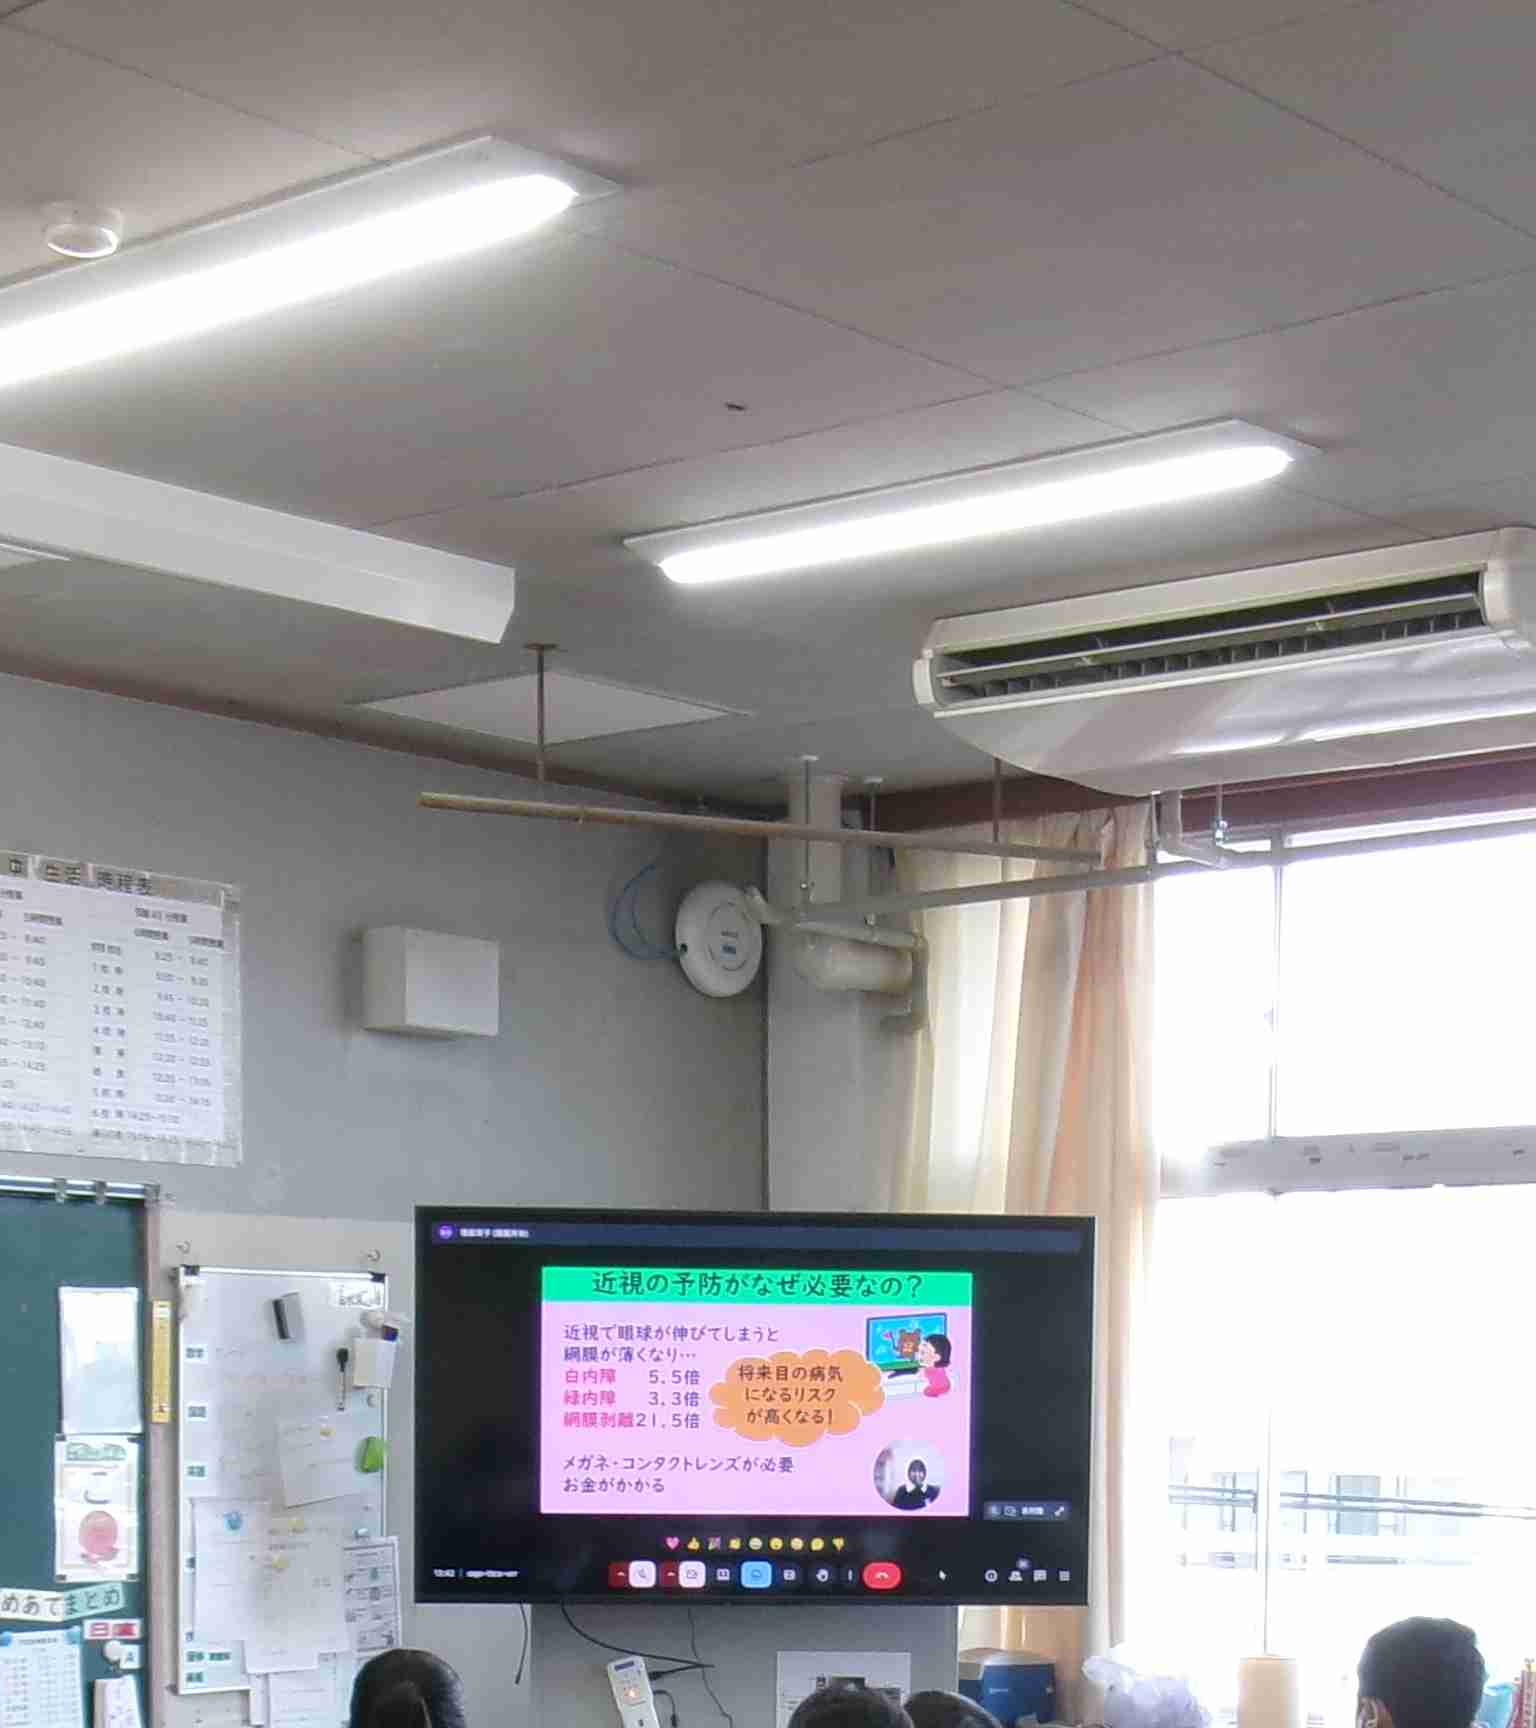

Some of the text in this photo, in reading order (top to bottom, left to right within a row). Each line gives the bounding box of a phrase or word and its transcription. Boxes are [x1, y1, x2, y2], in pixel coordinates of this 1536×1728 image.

[592, 1270, 923, 1300] 近視の予防がなぜ必要なの?
[563, 1323, 780, 1343] 近視で眼球が伸びてしまうと
[565, 1367, 617, 1385] 白内障
[738, 1364, 844, 1382] 将来目の病気
[744, 1387, 837, 1403] になるリスク
[562, 1455, 795, 1474] メガネ・コンタクトレンズが必要
[562, 1477, 666, 1494] お金がかかる
[0, 1594, 64, 1617] めあて
[64, 1586, 121, 1616] まとめ
